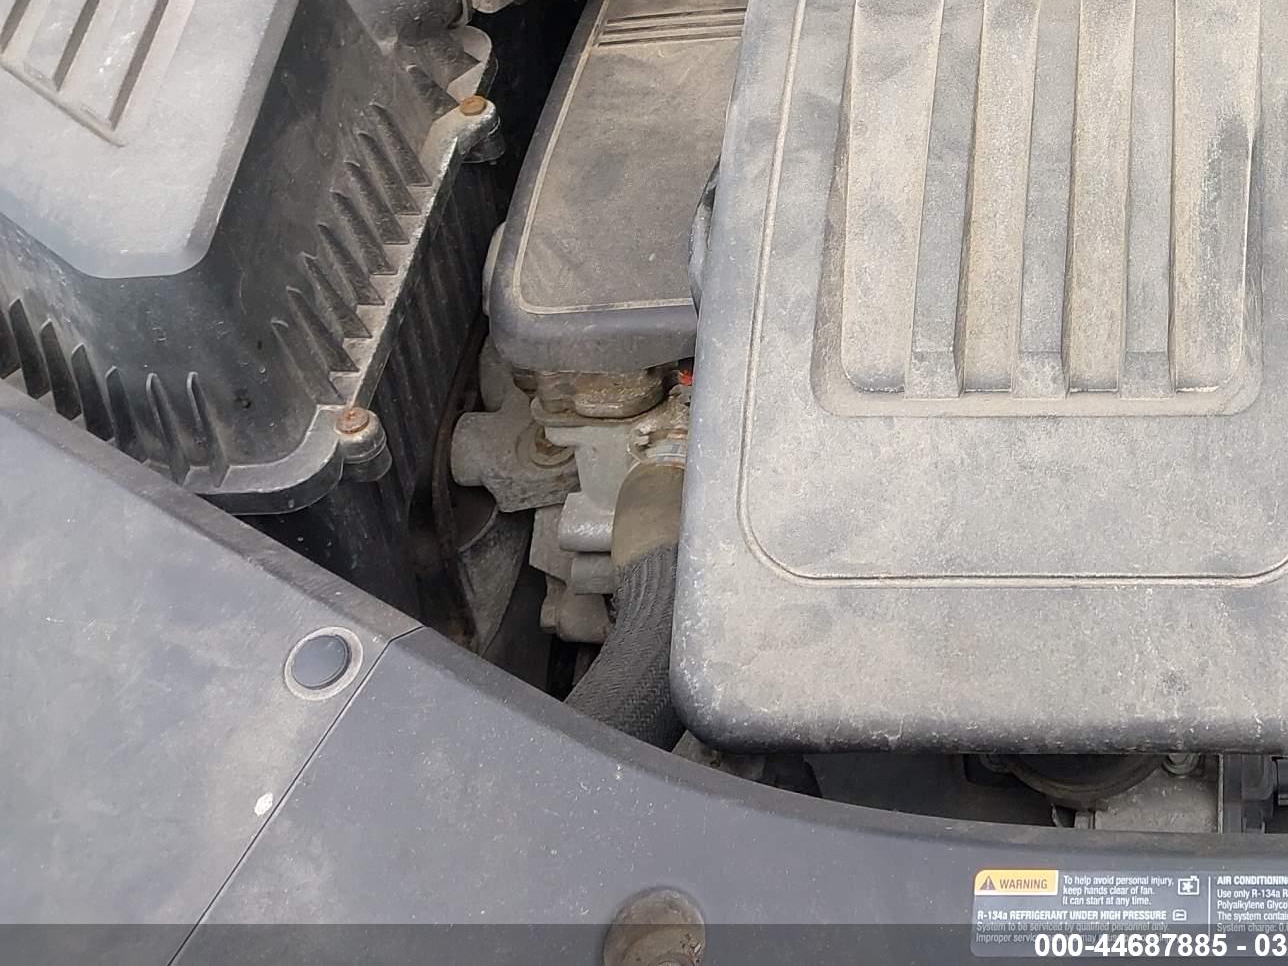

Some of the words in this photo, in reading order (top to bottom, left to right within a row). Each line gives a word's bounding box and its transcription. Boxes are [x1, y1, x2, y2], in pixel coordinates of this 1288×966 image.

[1000, 879, 1048, 889] WARNING
[1064, 875, 1072, 885] To
[1074, 875, 1092, 887] help
[1093, 875, 1114, 885] avoid
[1116, 875, 1149, 886] personal
[1150, 875, 1174, 887] injury,
[1217, 876, 1232, 885] AIR
[1063, 886, 1082, 896] keep
[1084, 886, 1108, 895] hands
[1109, 886, 1130, 895] clear
[1131, 886, 1139, 895] of
[1140, 886, 1155, 895] fan.
[1217, 889, 1232, 898] Use
[1234, 889, 1250, 900] only
[1252, 889, 1280, 898] R-134a
[1062, 896, 1068, 905] It
[1086, 896, 1104, 905] start
[1106, 896, 1114, 905] at
[1116, 897, 1130, 907] any
[1132, 896, 1152, 905] time.
[1217, 900, 1265, 911] Polyalkylene
[977, 910, 1008, 920] R-134a
[1010, 910, 1068, 920] REFRIGERANT
[1070, 910, 1098, 920] UNDER
[1100, 910, 1120, 920] HIGH
[1122, 910, 1167, 920] PRESSURE
[1217, 912, 1232, 921] The
[1234, 912, 1262, 922] system
[976, 922, 1006, 932] System
[1008, 922, 1016, 930] to
[1018, 922, 1028, 930] be
[1030, 922, 1062, 930] serviced
[1064, 922, 1075, 932] by
[1076, 921, 1110, 932] qualified
[1112, 922, 1150, 932] personnel
[1216, 923, 1246, 933] System
[976, 933, 1010, 943] Improper
